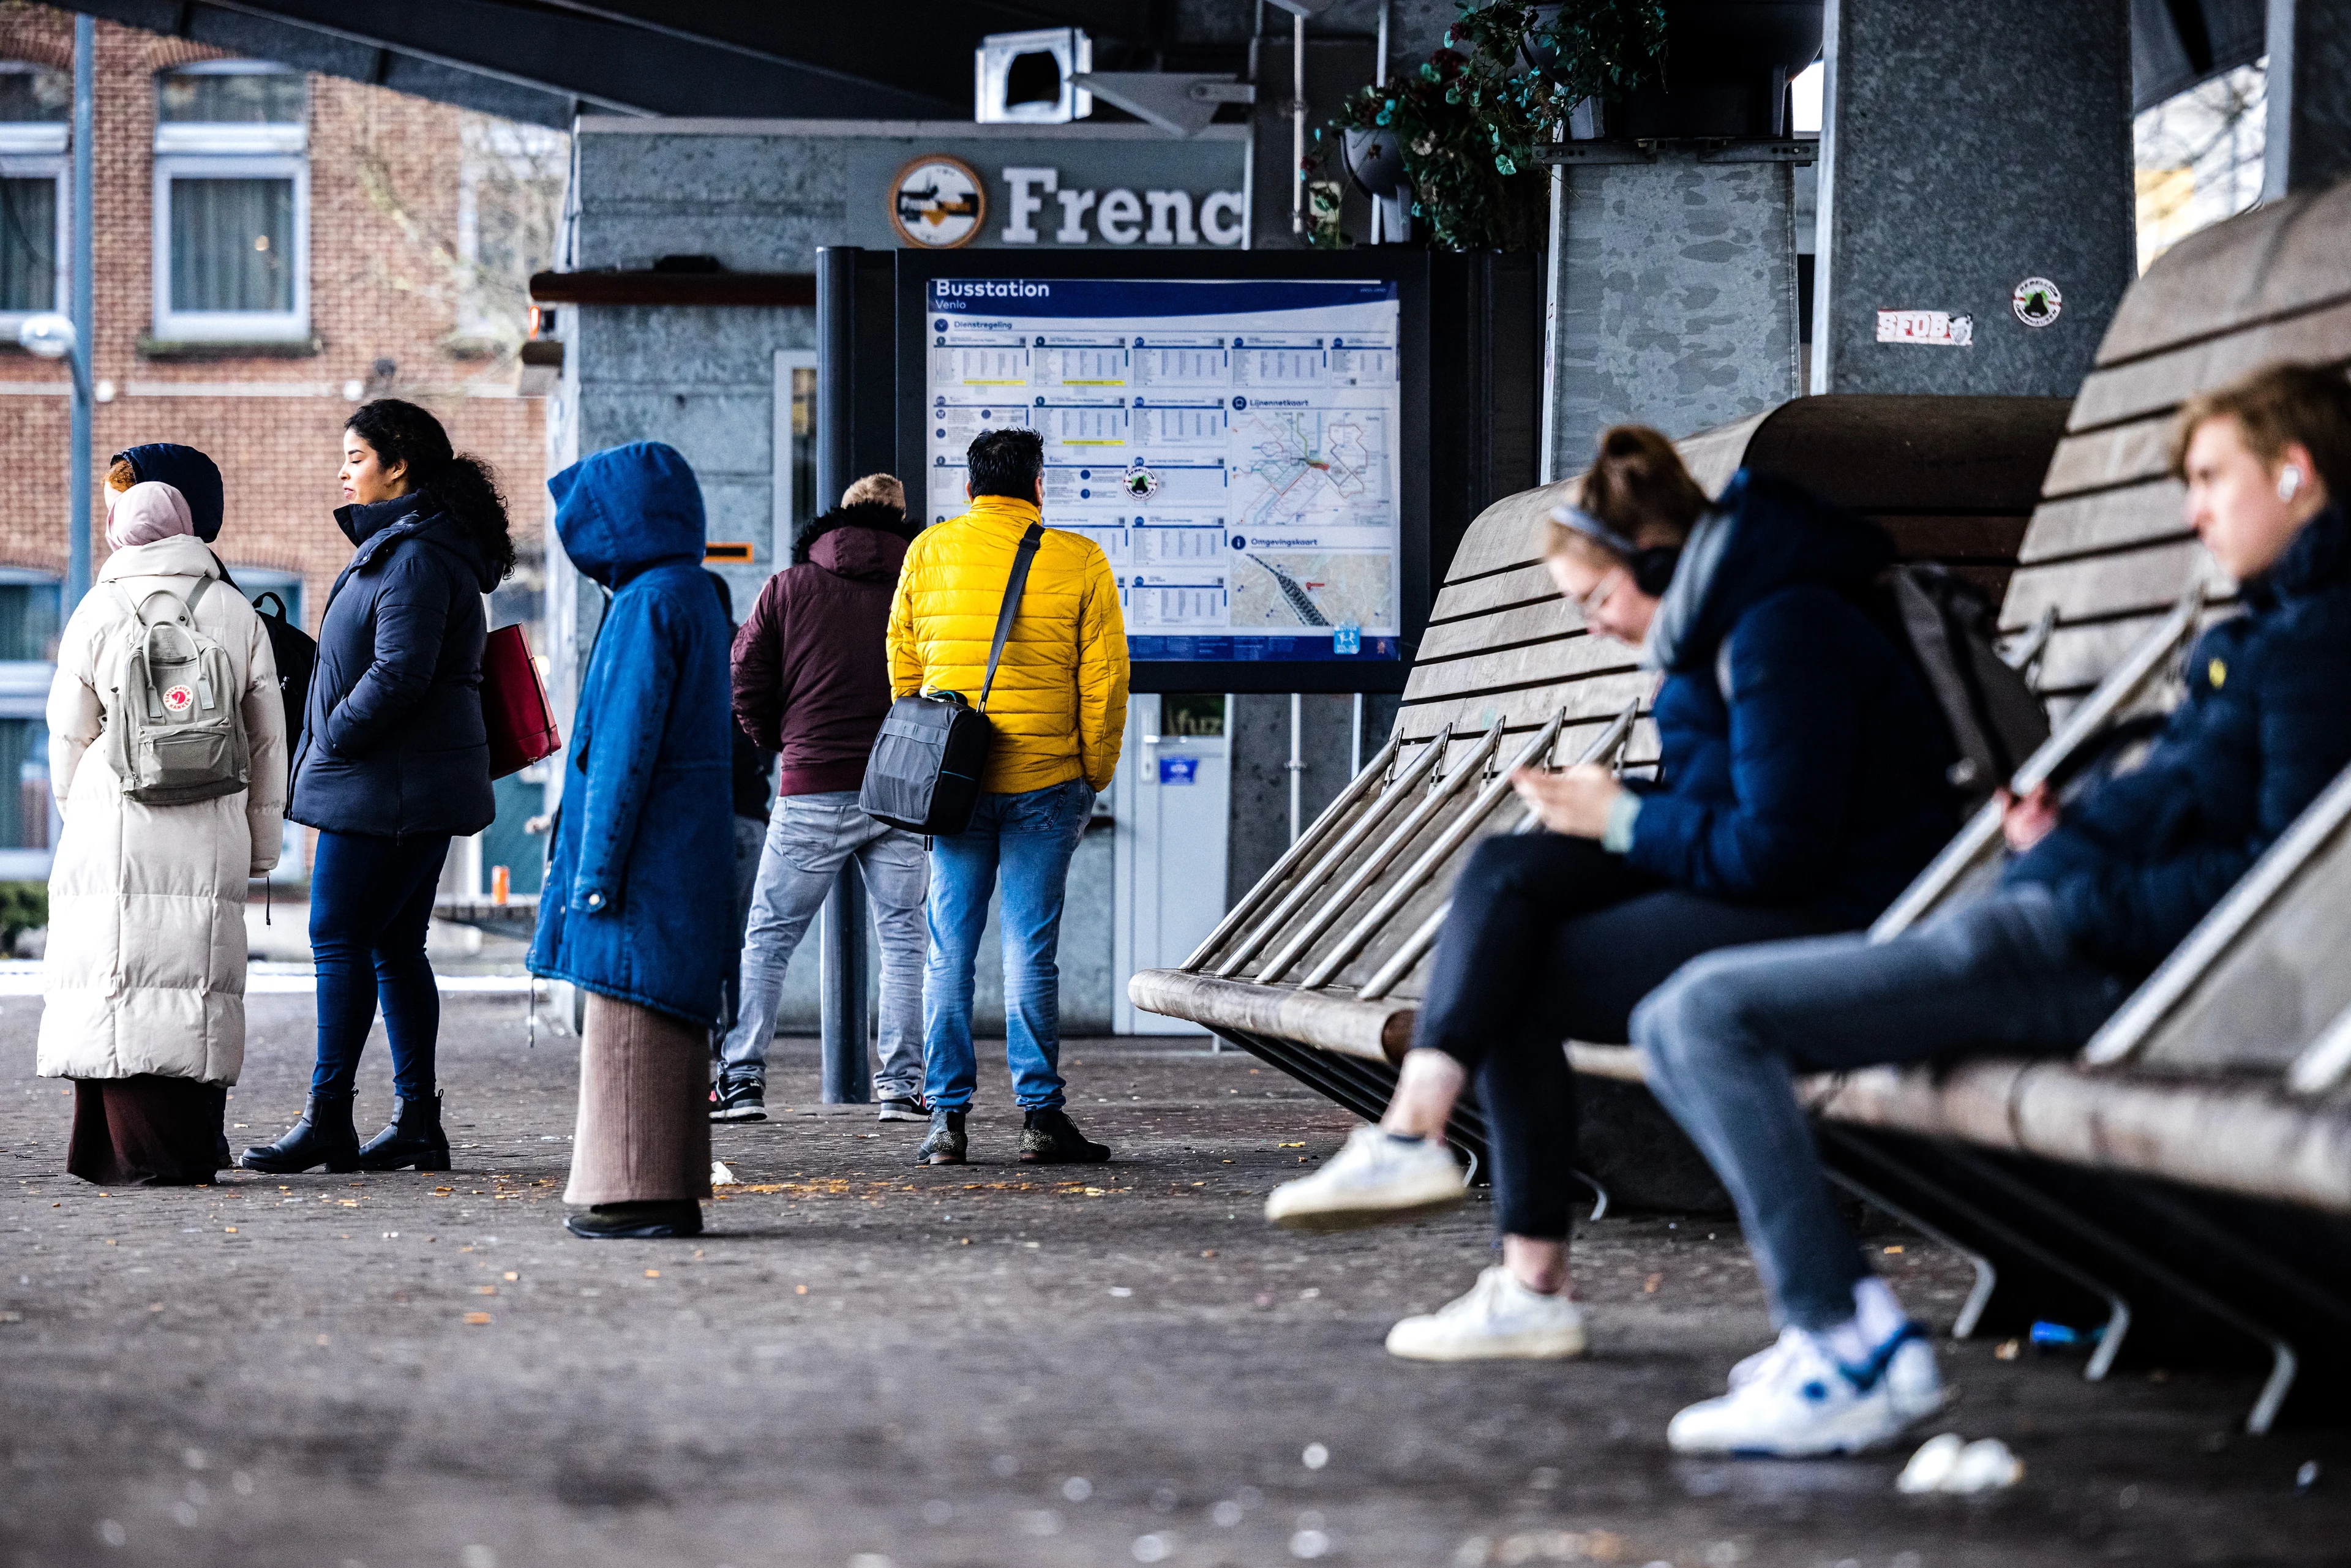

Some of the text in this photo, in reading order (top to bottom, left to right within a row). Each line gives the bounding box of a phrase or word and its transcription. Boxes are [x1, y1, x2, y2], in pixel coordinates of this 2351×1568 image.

[936, 279, 1051, 297] Busstation
[935, 299, 967, 309] Venlo
[954, 320, 1013, 330] Dienstregeling
[1250, 399, 1309, 408] Lijnennetkaart
[1251, 538, 1318, 547] Omgevingskaart
